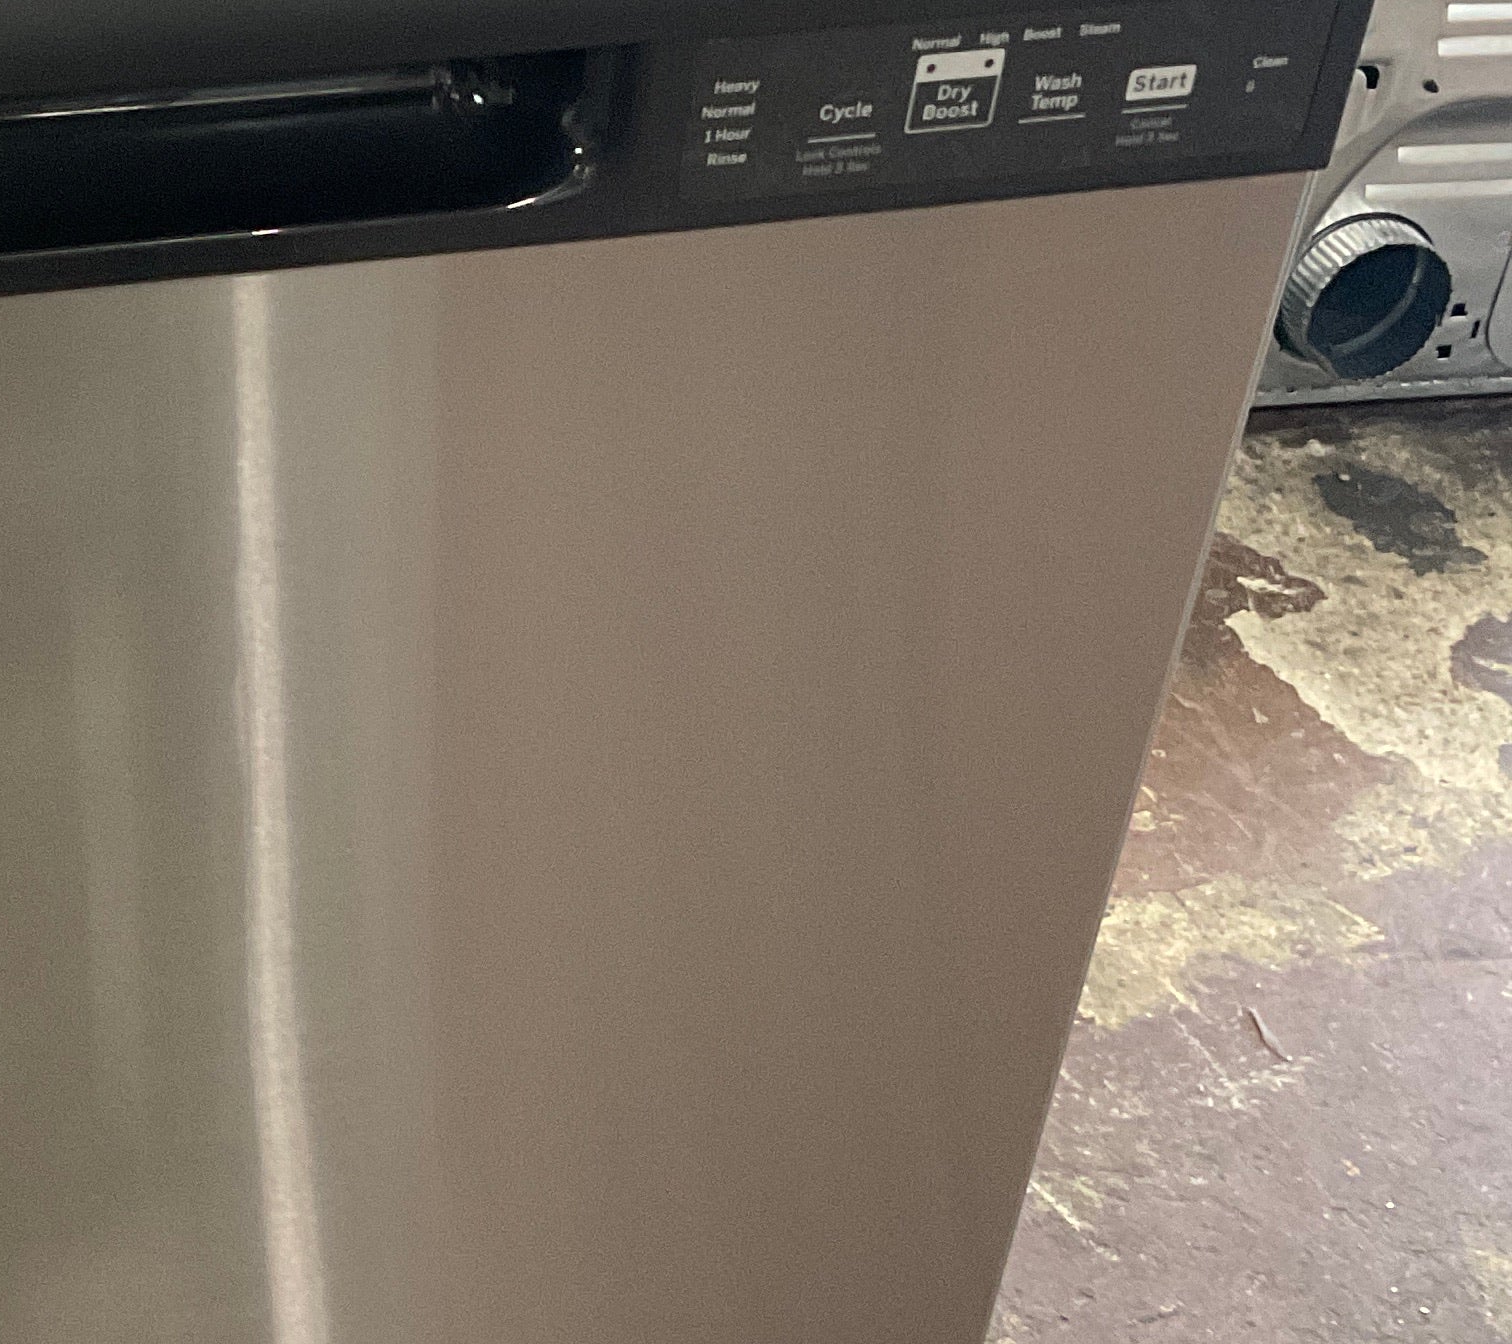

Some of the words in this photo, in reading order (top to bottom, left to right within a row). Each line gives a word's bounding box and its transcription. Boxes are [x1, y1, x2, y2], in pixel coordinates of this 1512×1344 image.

[912, 33, 962, 51] Normal
[714, 79, 761, 94] Heavy
[1035, 72, 1083, 91] Wash
[1133, 72, 1188, 93] Start
[938, 84, 973, 103] Dry
[1031, 94, 1079, 111] Temp
[701, 102, 756, 119] Normal
[819, 101, 874, 124] Cycle
[922, 100, 979, 121] Boost
[704, 129, 712, 144] 1
[715, 127, 752, 142] Hour
[707, 152, 748, 166] Rinse
